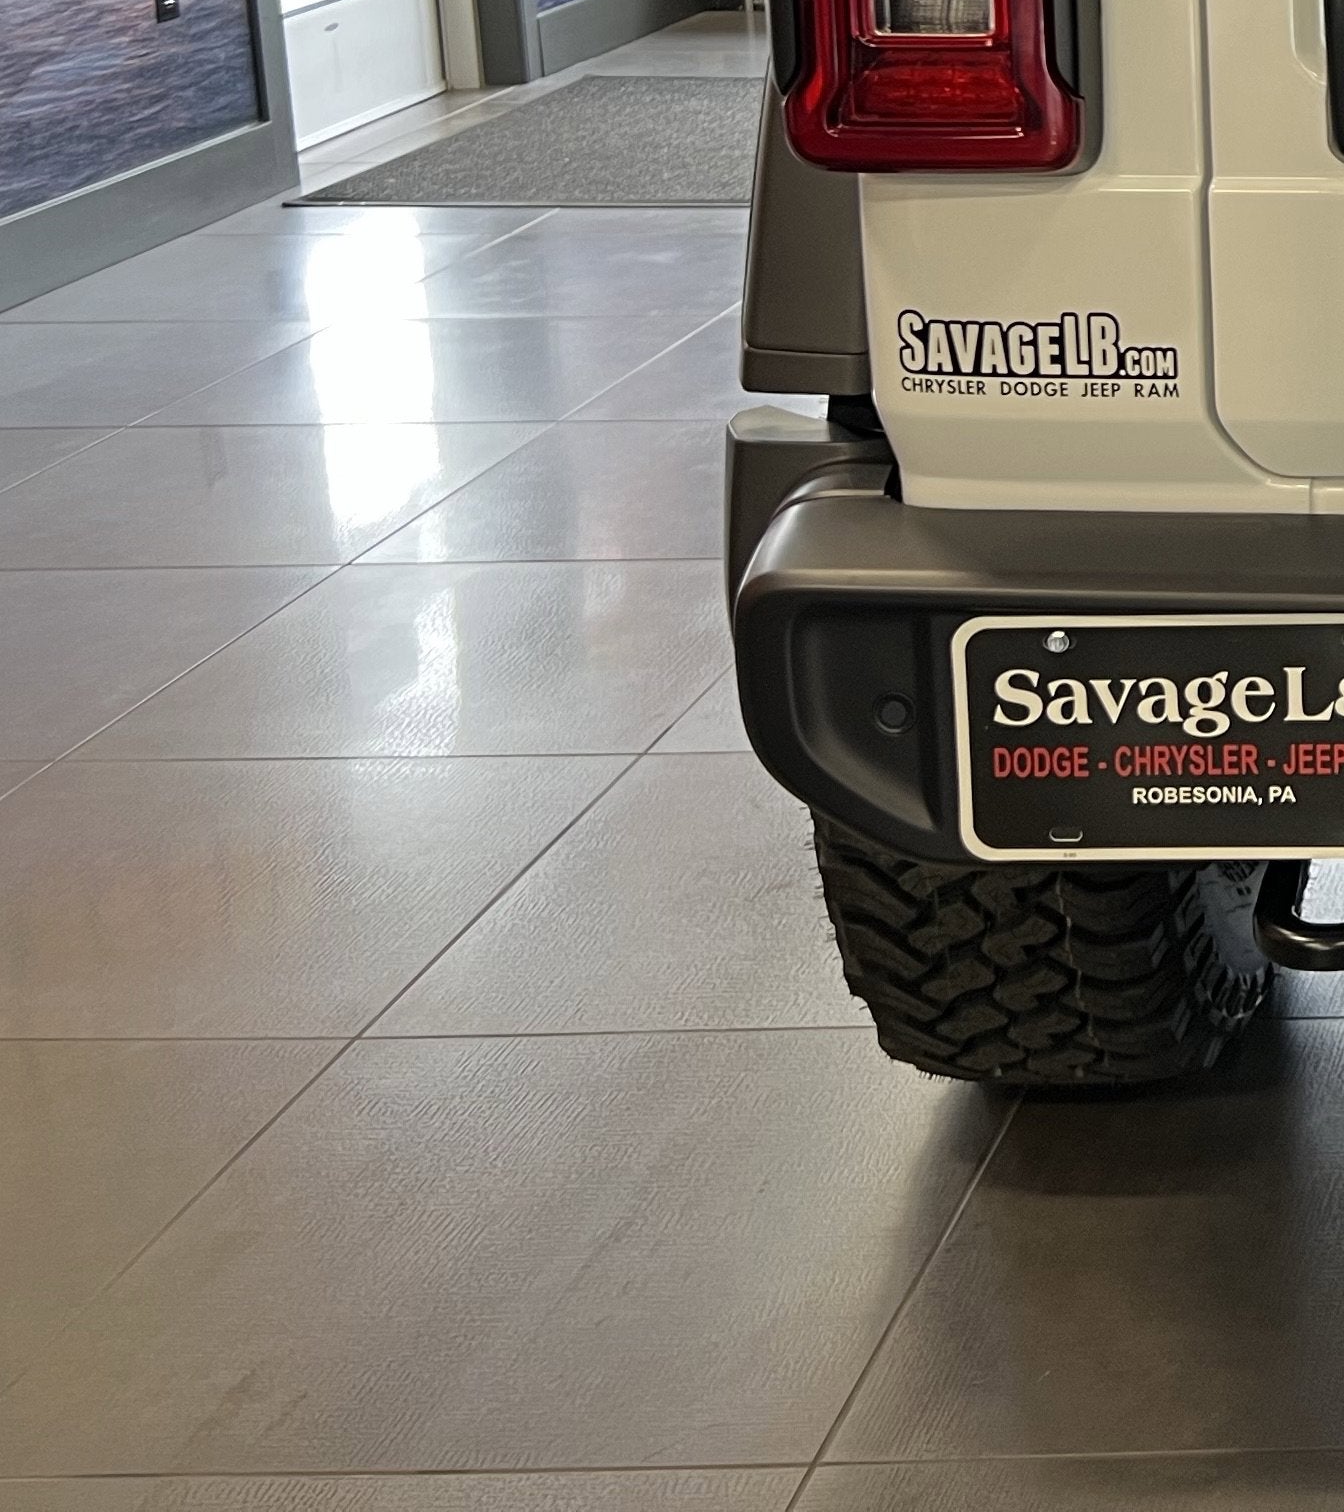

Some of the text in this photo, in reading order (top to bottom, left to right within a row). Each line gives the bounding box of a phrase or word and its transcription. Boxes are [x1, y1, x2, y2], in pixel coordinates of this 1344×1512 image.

[901, 377, 1180, 398] CHRYSLER DODGE JEEP RAM
[993, 745, 1090, 779] DODGE
[1113, 744, 1259, 777] CHRYSLER
[1132, 786, 1297, 806] ROBESONIA, PA
